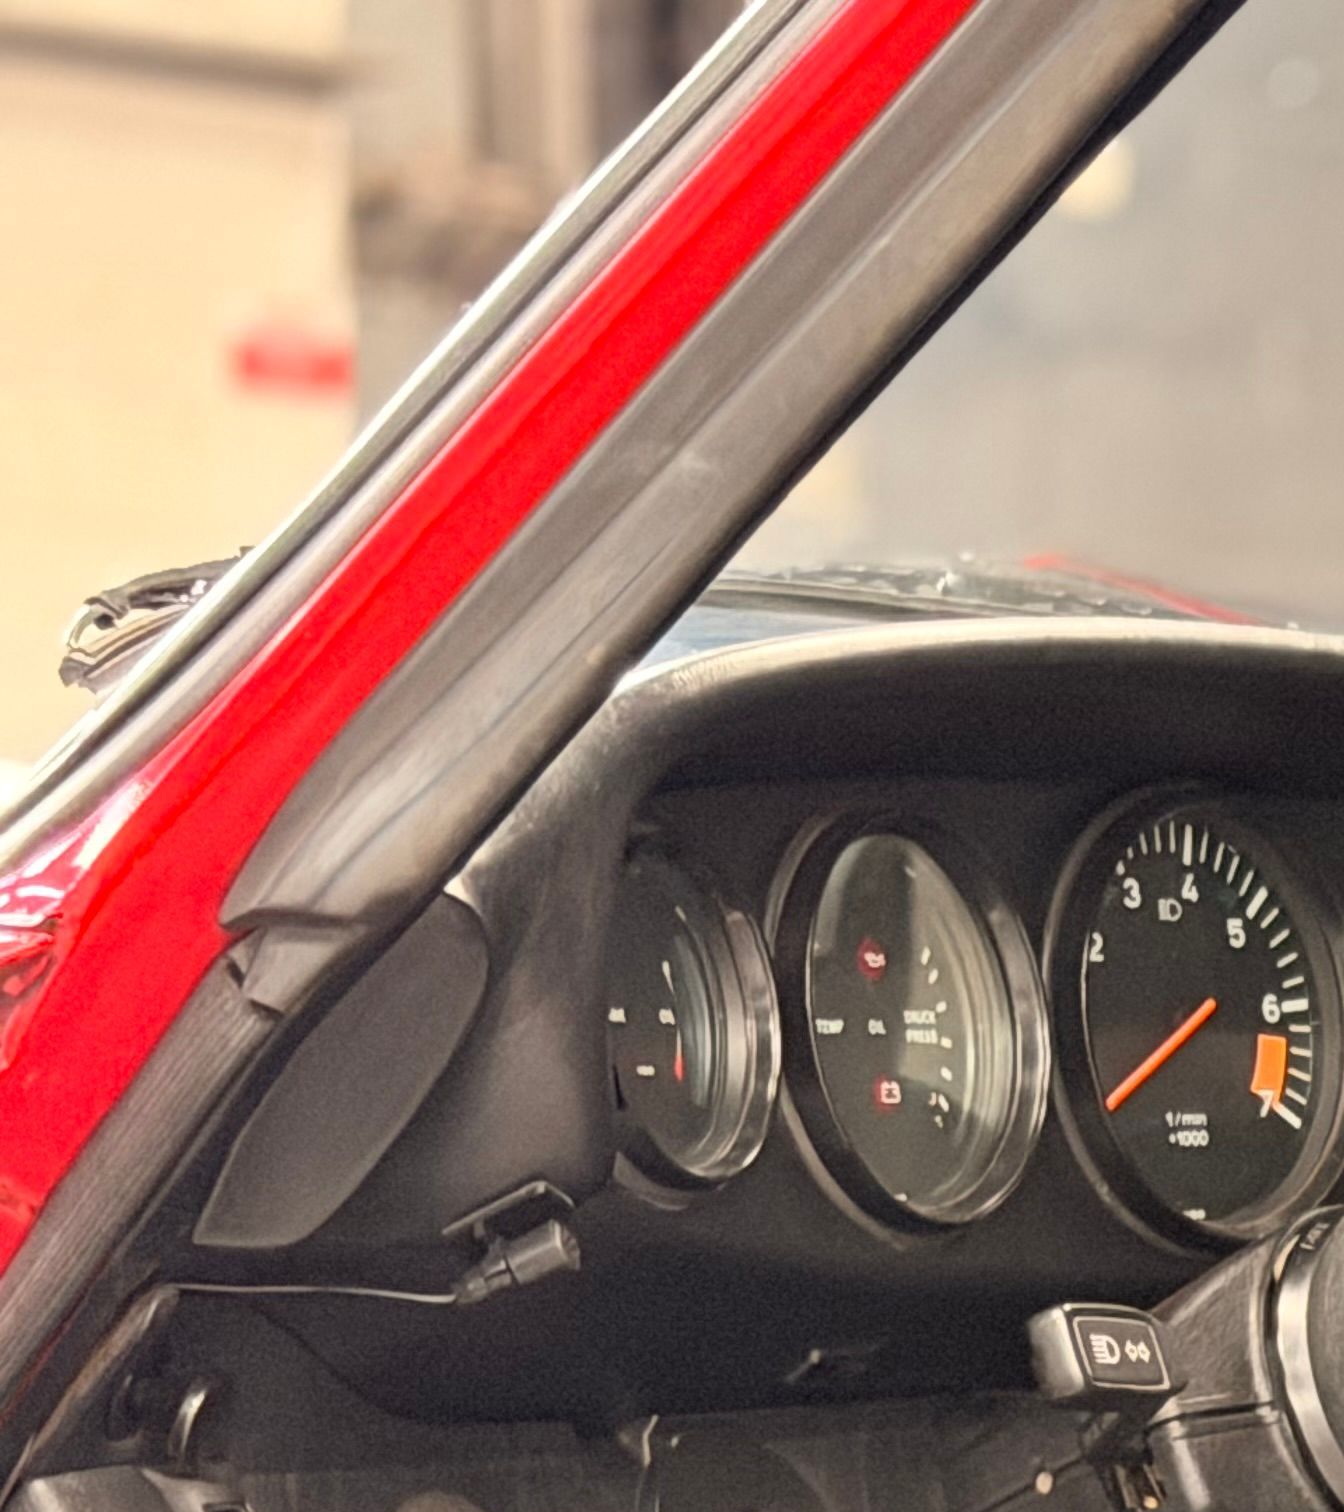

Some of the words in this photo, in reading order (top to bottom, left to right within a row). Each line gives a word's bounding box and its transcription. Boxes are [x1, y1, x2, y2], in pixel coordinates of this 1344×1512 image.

[1122, 878, 1142, 908] 3
[1181, 873, 1199, 902] 4
[1089, 932, 1105, 962] 2
[1226, 917, 1246, 948] 5
[1261, 993, 1281, 1023] 6
[1257, 1088, 1276, 1118] 7
